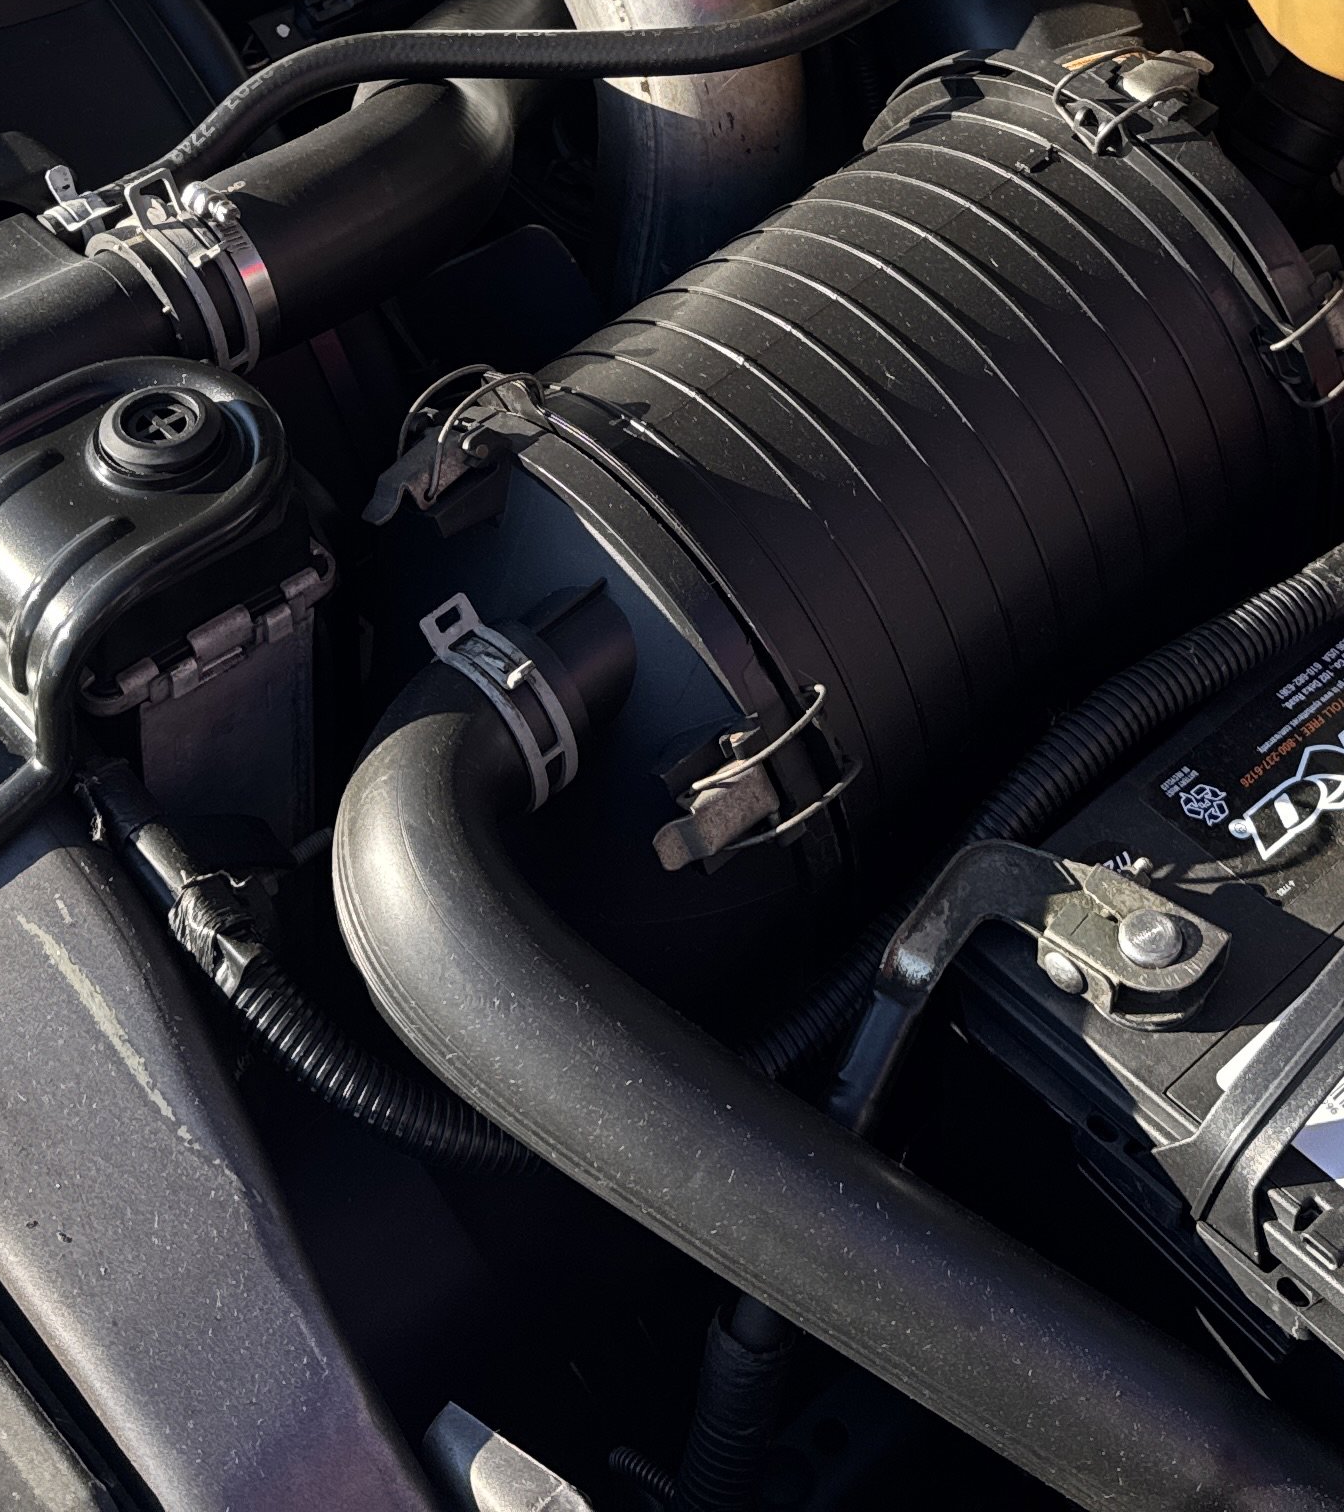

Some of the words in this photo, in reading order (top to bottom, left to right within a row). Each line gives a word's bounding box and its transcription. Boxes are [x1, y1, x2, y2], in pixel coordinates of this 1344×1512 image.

[1320, 646, 1339, 664] USA
[1317, 668, 1334, 684] 102
[1300, 677, 1322, 697] Deka
[1299, 714, 1325, 737] FREE
[1237, 732, 1304, 788] 1-800-237-6126
